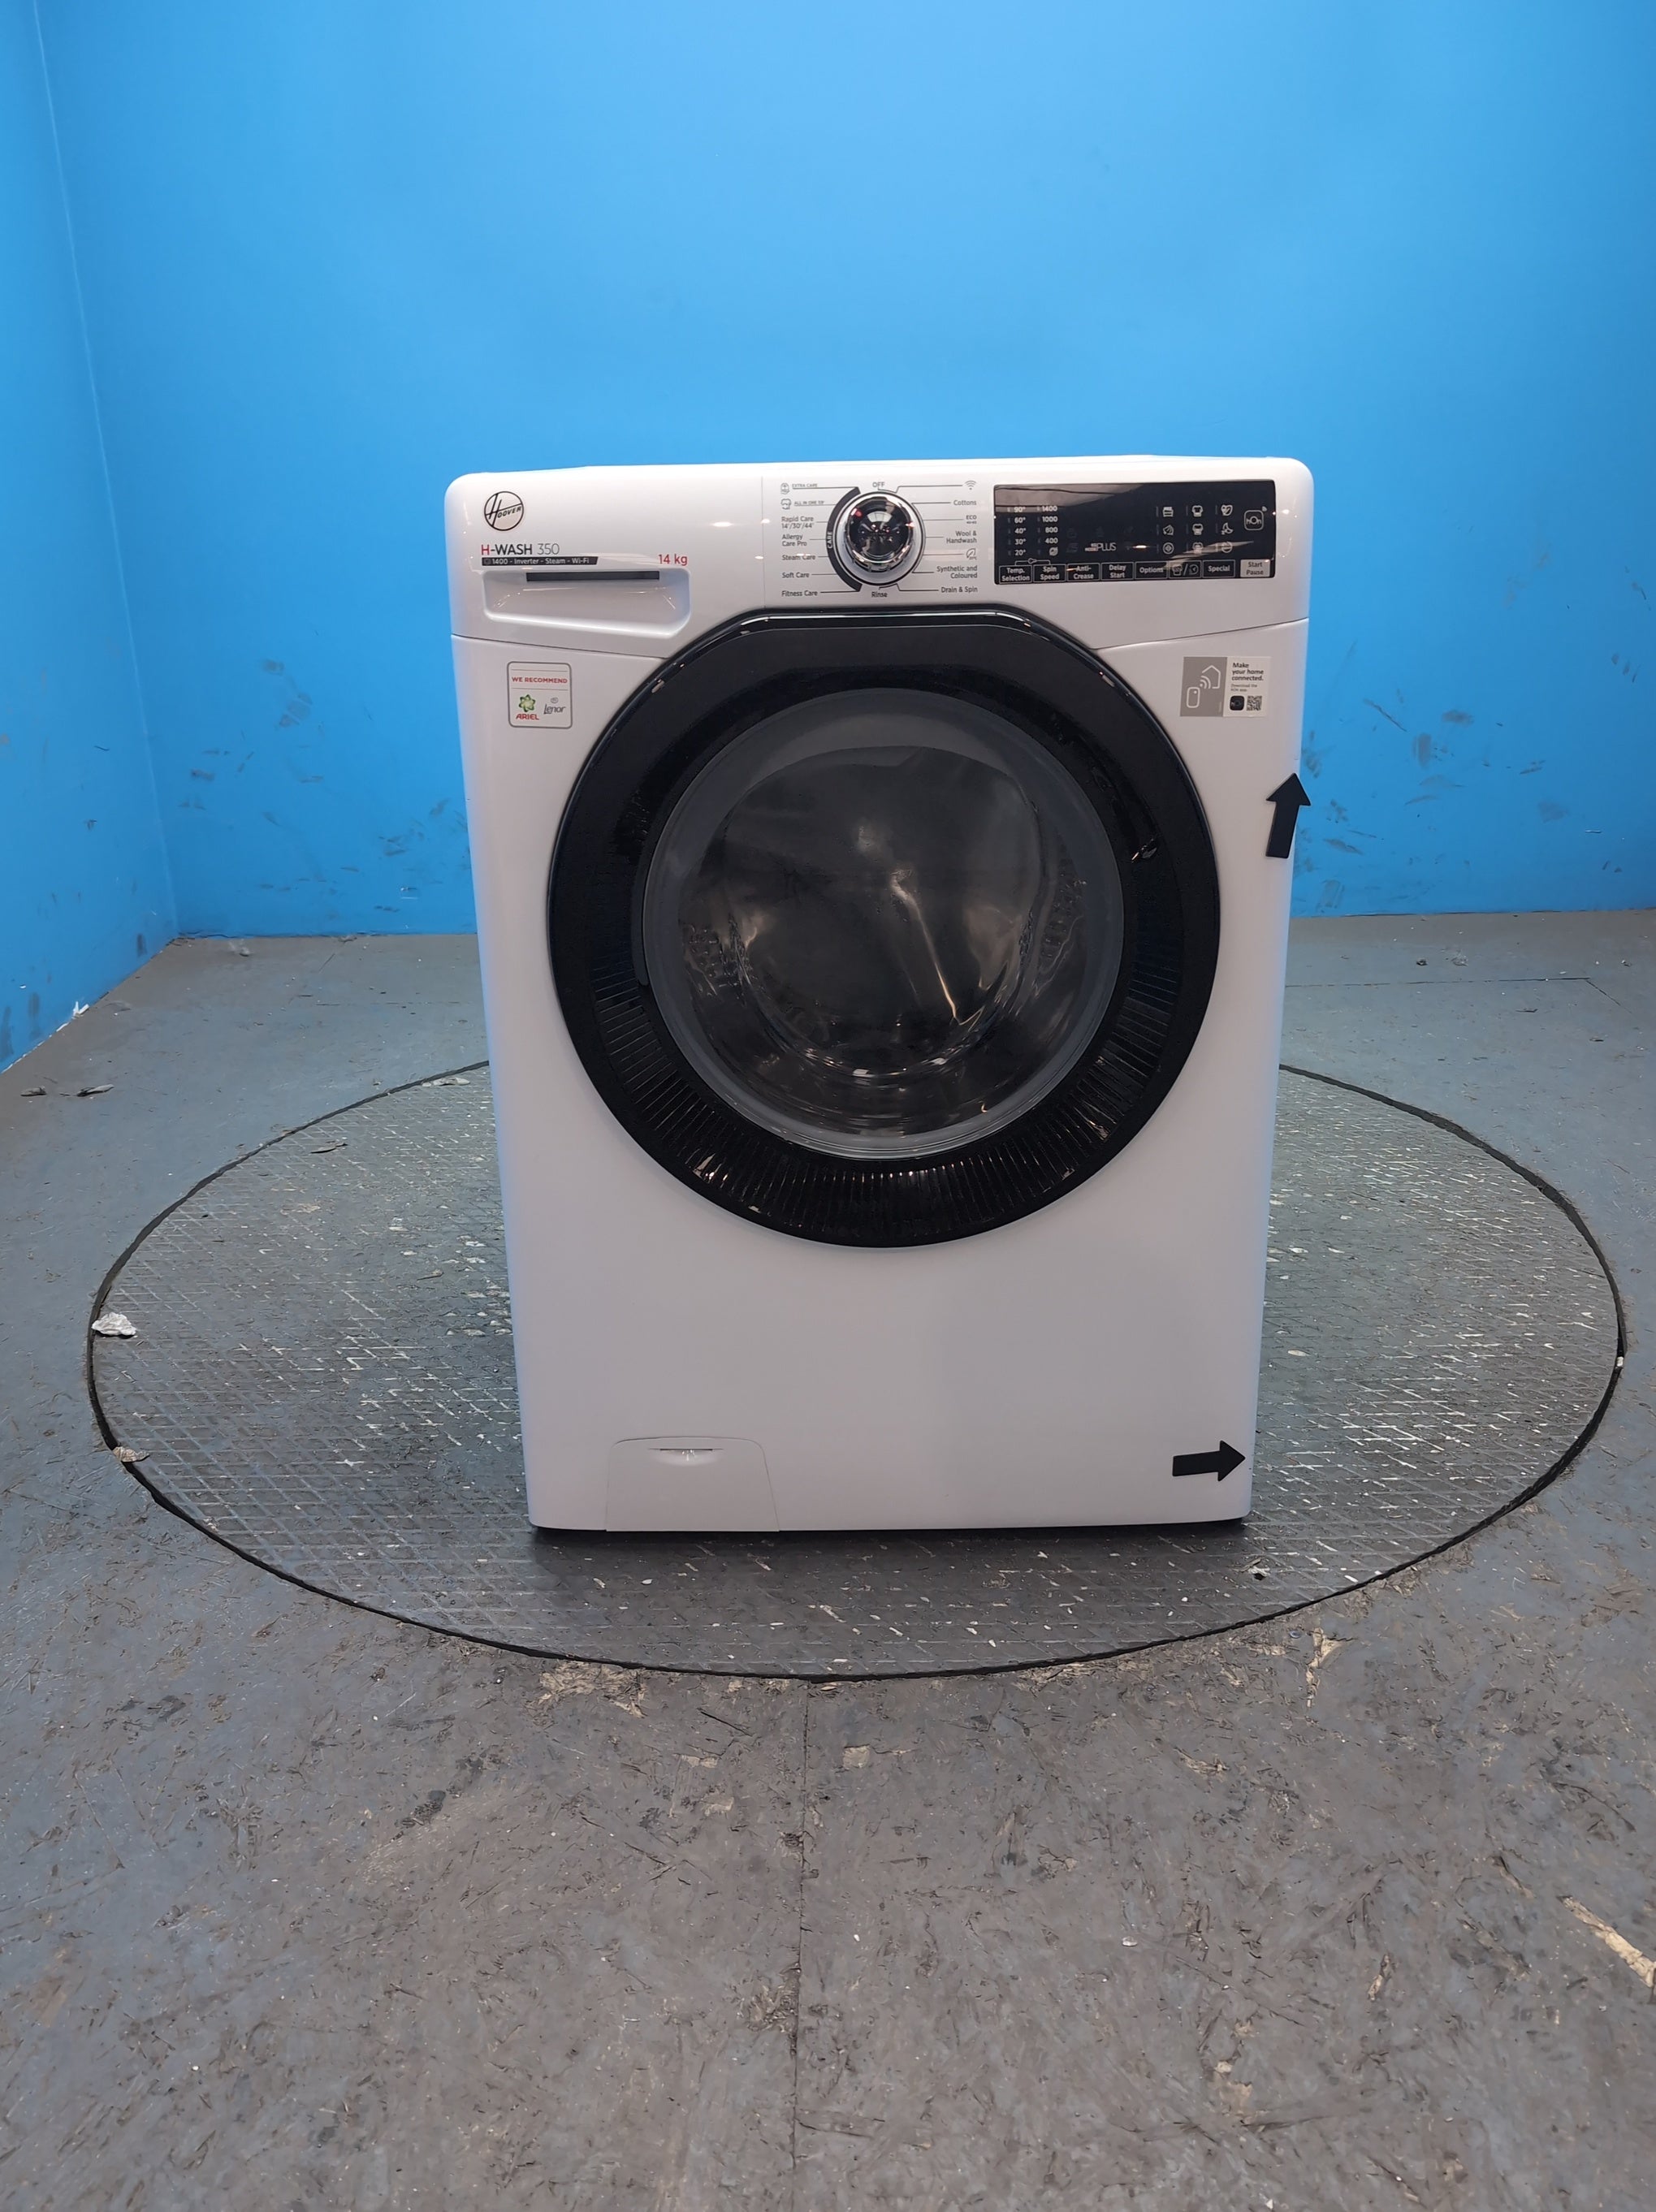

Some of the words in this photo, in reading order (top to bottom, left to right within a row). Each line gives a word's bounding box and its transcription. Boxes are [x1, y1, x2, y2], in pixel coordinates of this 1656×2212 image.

[481, 543, 532, 555] H-WASH
[537, 542, 560, 555] 350
[1097, 542, 1117, 551] PLUS
[658, 555, 670, 564] 14
[673, 555, 688, 566] kg
[1109, 564, 1126, 572] Delay
[1139, 566, 1164, 574] Options
[543, 703, 566, 715] Lenor
